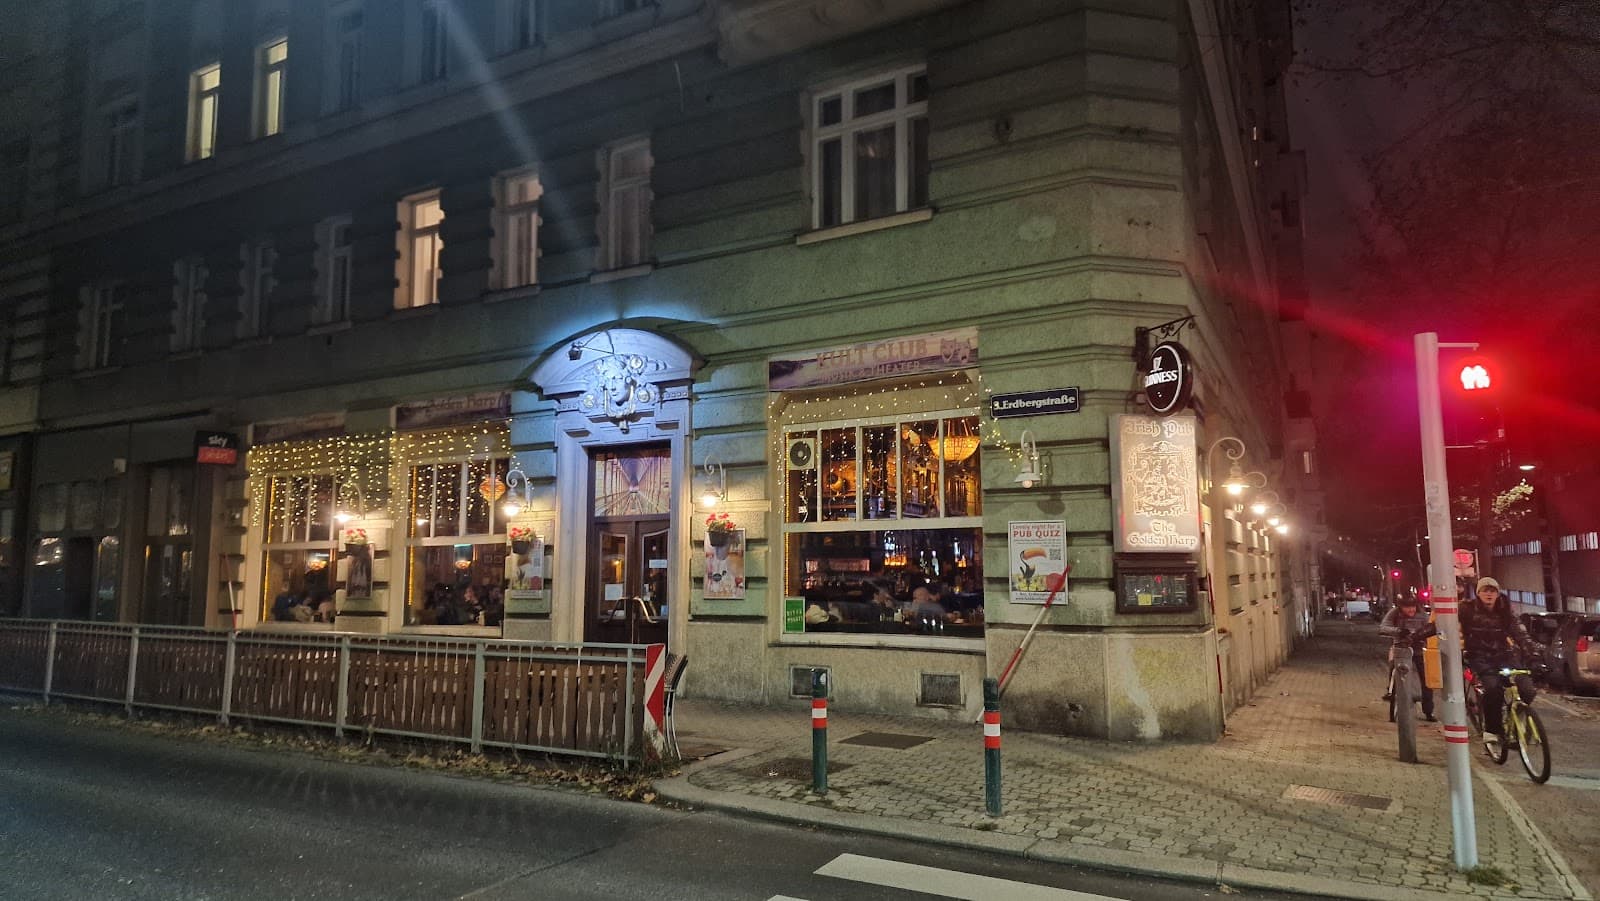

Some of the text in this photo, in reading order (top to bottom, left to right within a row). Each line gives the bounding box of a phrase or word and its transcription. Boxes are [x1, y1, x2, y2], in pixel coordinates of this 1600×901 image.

[816, 338, 928, 369] KULT CLUB
[870, 360, 921, 377] THEATER
[1125, 420, 1194, 437] Irish Pub
[208, 434, 229, 448] sky
[1151, 520, 1174, 532] The
[1013, 530, 1061, 539] PUB QUIZ
[1129, 534, 1196, 547] Golden Harp
